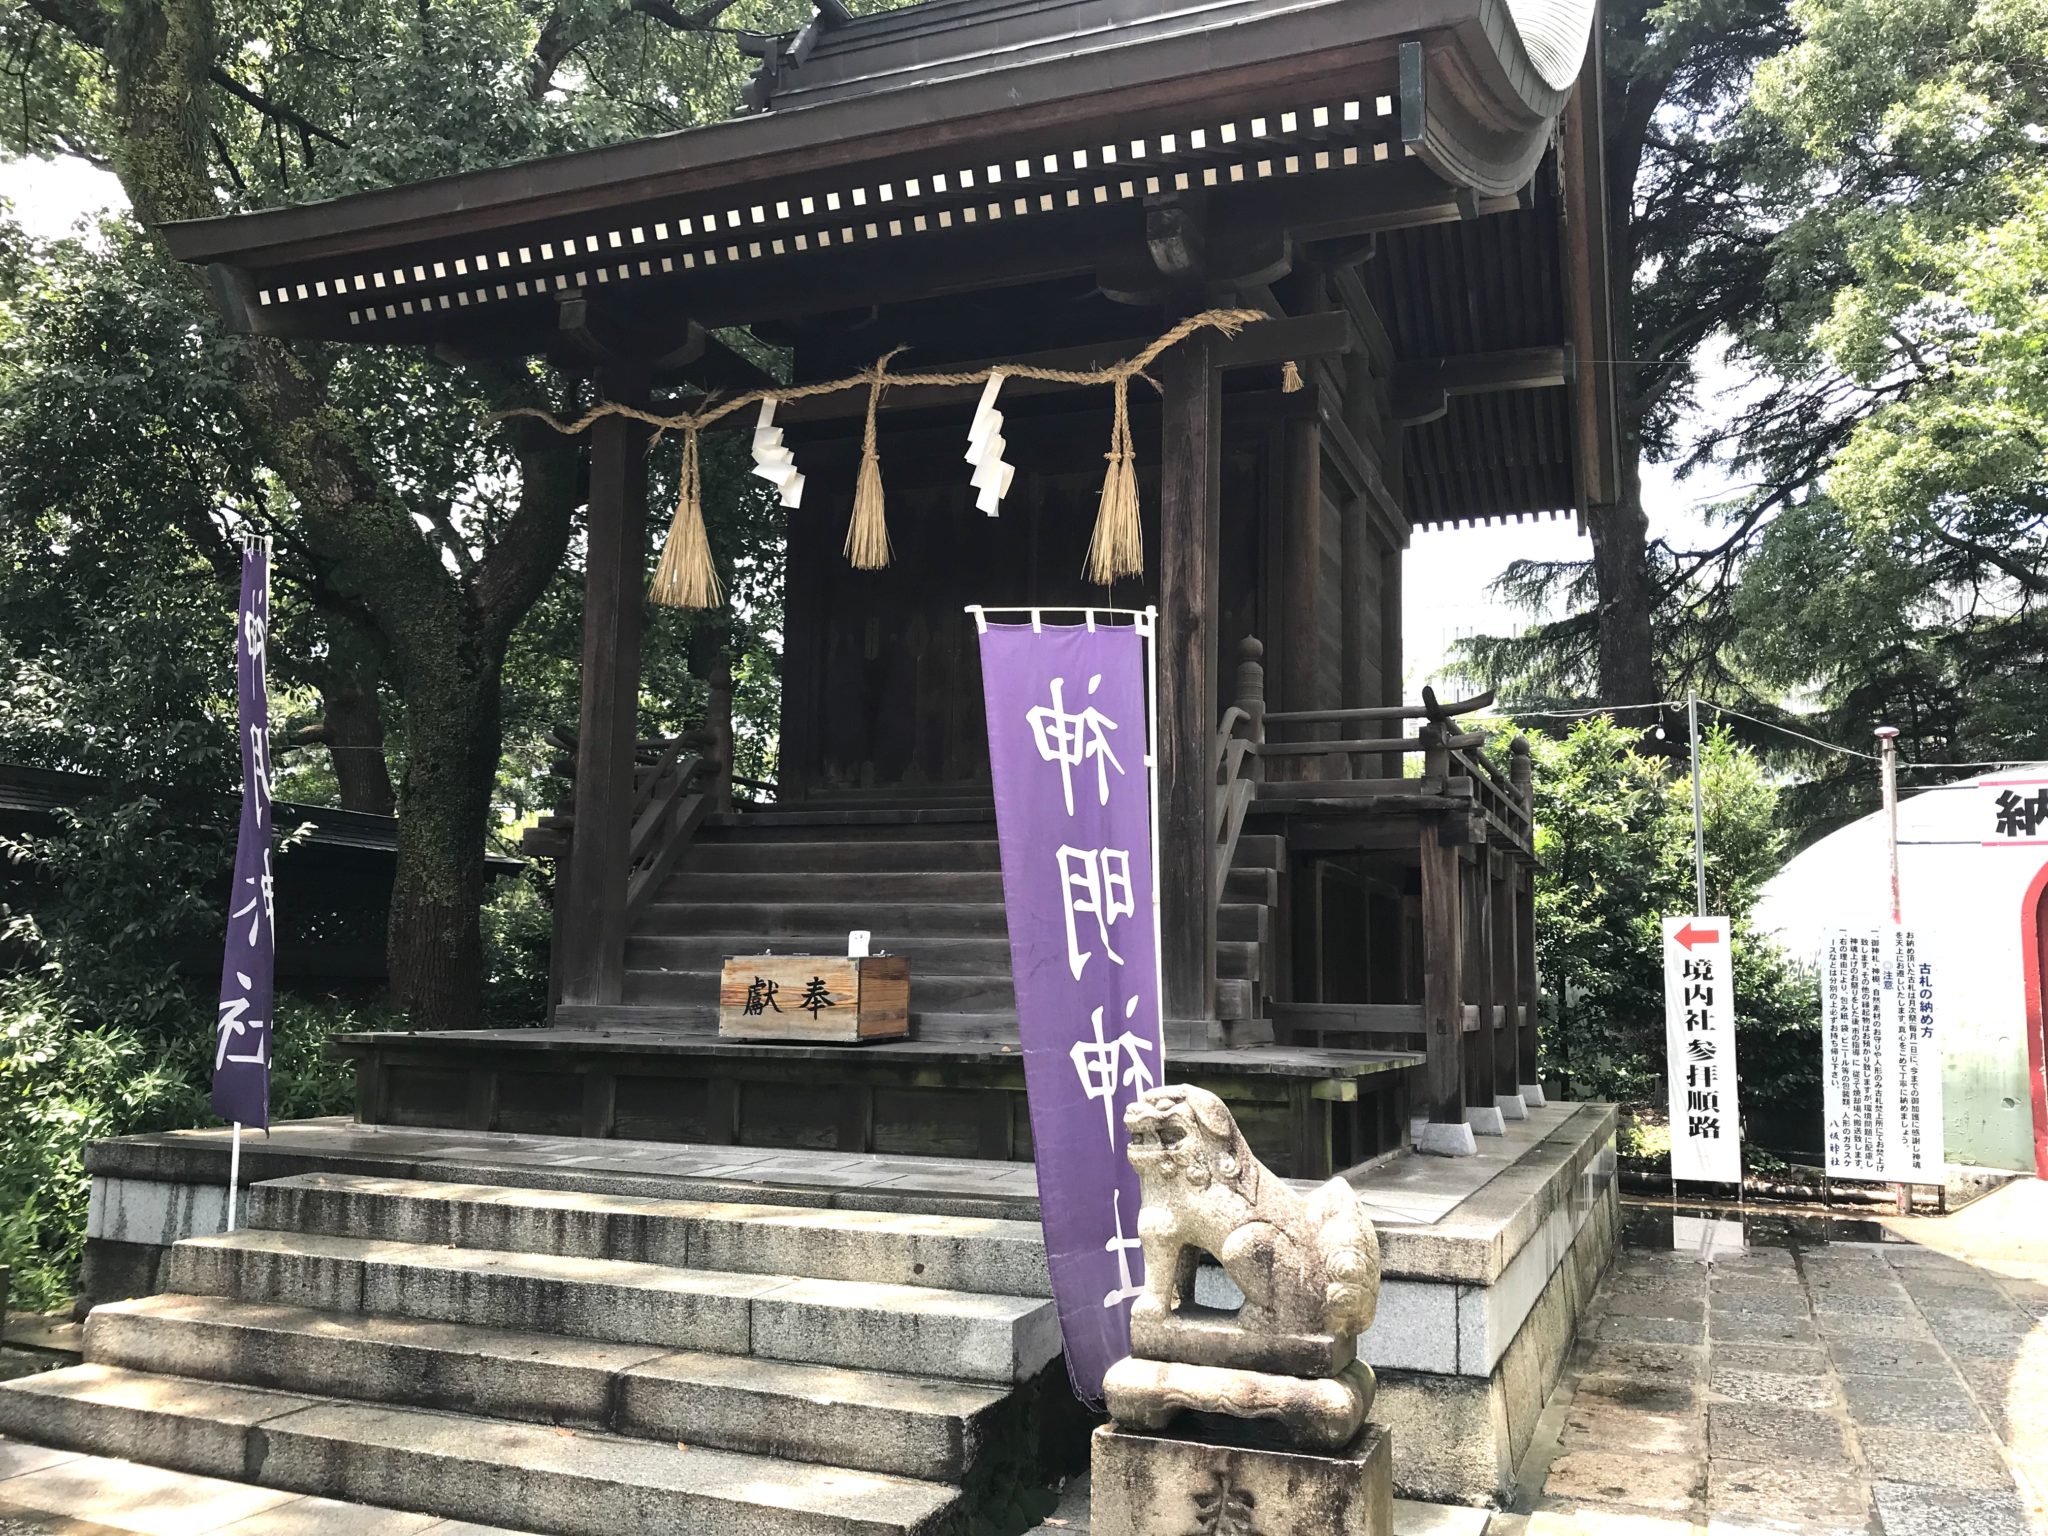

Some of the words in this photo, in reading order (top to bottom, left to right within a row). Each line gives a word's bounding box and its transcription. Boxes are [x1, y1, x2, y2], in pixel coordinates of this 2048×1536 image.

[1919, 962, 1935, 1039] 古札の納め方
[1682, 958, 1721, 1139] 境内社参拝順路
[1829, 1119, 1840, 1166] 八坂神社
